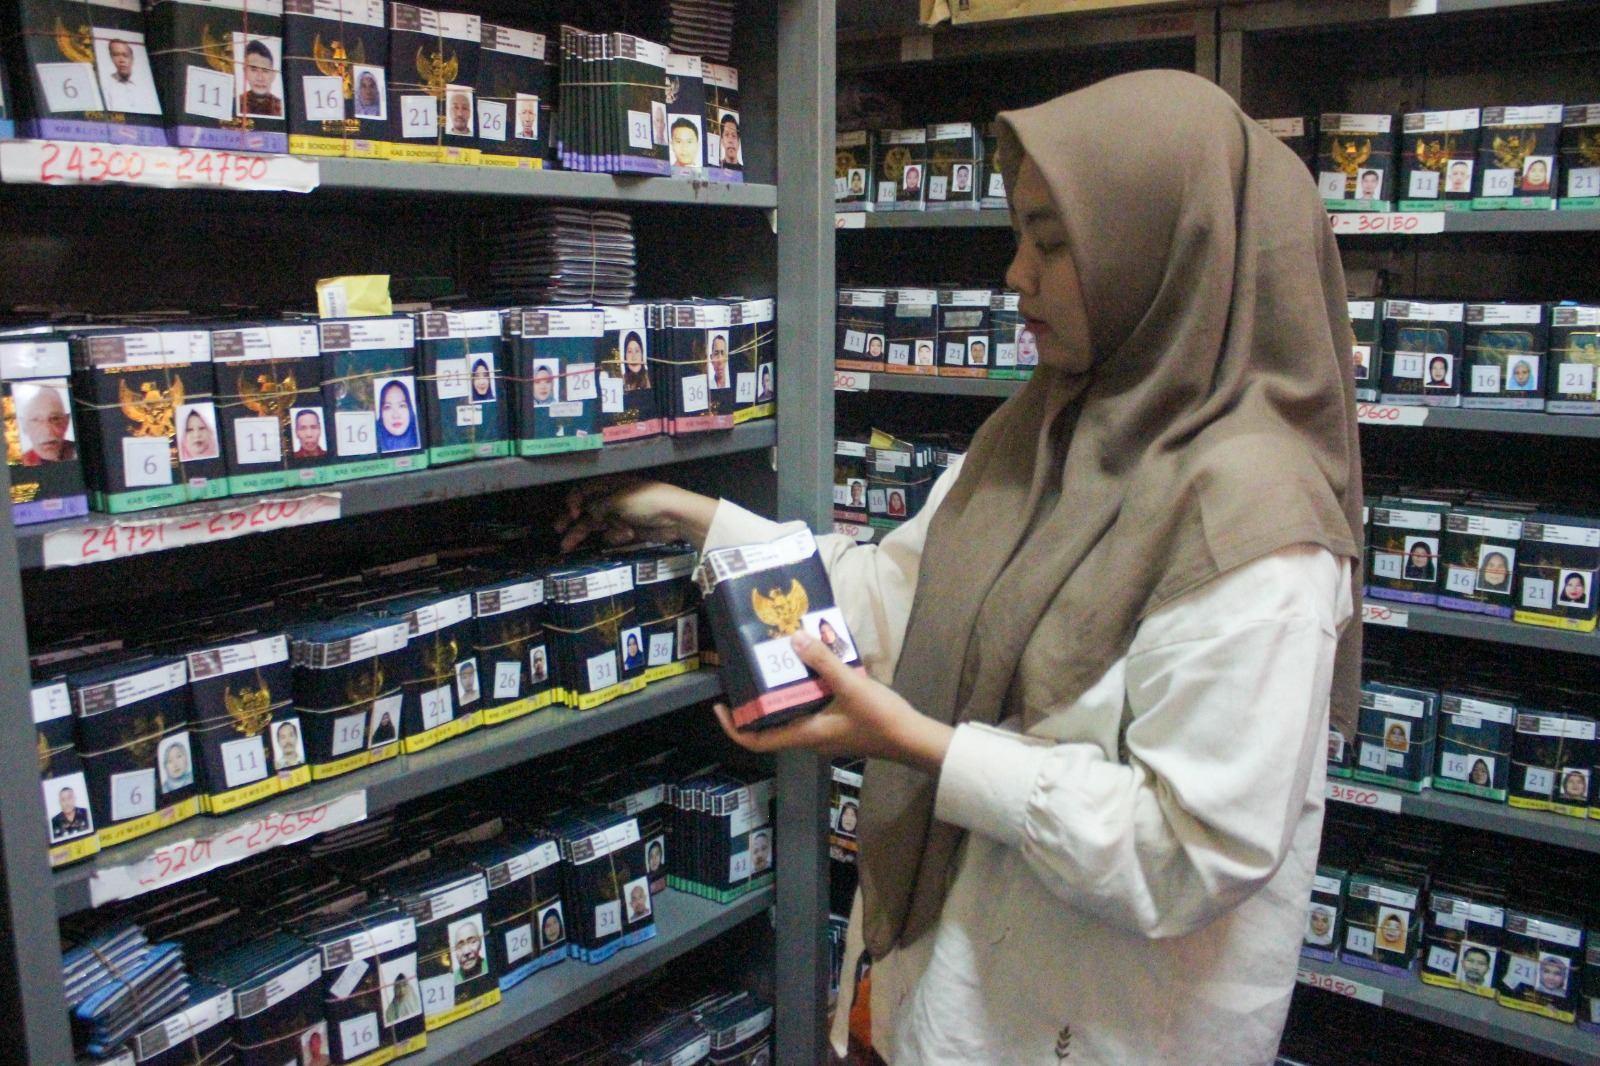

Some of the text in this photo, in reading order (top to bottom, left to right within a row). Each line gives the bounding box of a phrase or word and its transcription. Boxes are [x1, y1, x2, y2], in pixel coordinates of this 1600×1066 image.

[63, 78, 78, 99] 6
[197, 84, 221, 107] 11
[314, 90, 338, 109] 16
[409, 108, 431, 127] 21
[482, 112, 501, 131] 26
[635, 122, 648, 140] 31
[709, 143, 715, 158] 1
[41, 144, 145, 182] 24300
[176, 148, 267, 187] 24750
[932, 183, 944, 194] 21
[1328, 180, 1338, 192] 6
[1416, 177, 1433, 191] 11
[1490, 176, 1508, 190] 16
[1575, 175, 1593, 189] 21
[883, 187, 894, 198] 16
[1358, 214, 1419, 231] 30150
[894, 349, 906, 360] 16
[949, 349, 962, 360] 21
[1000, 349, 1014, 360] 26
[1402, 359, 1417, 372] 11
[443, 368, 462, 387] 21
[572, 374, 590, 391] 26
[1478, 374, 1496, 388] 16
[1565, 373, 1585, 387] 21
[688, 386, 703, 402] 36
[247, 432, 271, 452] 11
[346, 424, 368, 443] 16
[144, 455, 157, 475] 6
[82, 525, 164, 557] 24751
[1380, 559, 1395, 572] 11
[1452, 572, 1470, 586] 16
[1528, 586, 1546, 600] 21
[653, 643, 669, 658] 36
[767, 651, 795, 674] 36
[595, 662, 612, 681] 31
[500, 672, 516, 689] 26
[428, 698, 446, 719] 21
[341, 723, 361, 744] 16
[236, 750, 258, 772] 11
[1366, 750, 1382, 764] 11
[1447, 759, 1464, 773] 16
[1528, 773, 1547, 788] 21
[130, 785, 142, 805] 6
[1331, 785, 1379, 805] 31500
[139, 840, 213, 886] 5201
[247, 804, 328, 849] 25650
[734, 858, 746, 874] 41
[600, 910, 615, 927] 31
[510, 933, 528, 953] 26
[1434, 953, 1451, 968] 16
[1513, 962, 1531, 979] 21
[426, 986, 446, 1005] 21
[351, 1025, 373, 1048] 16
